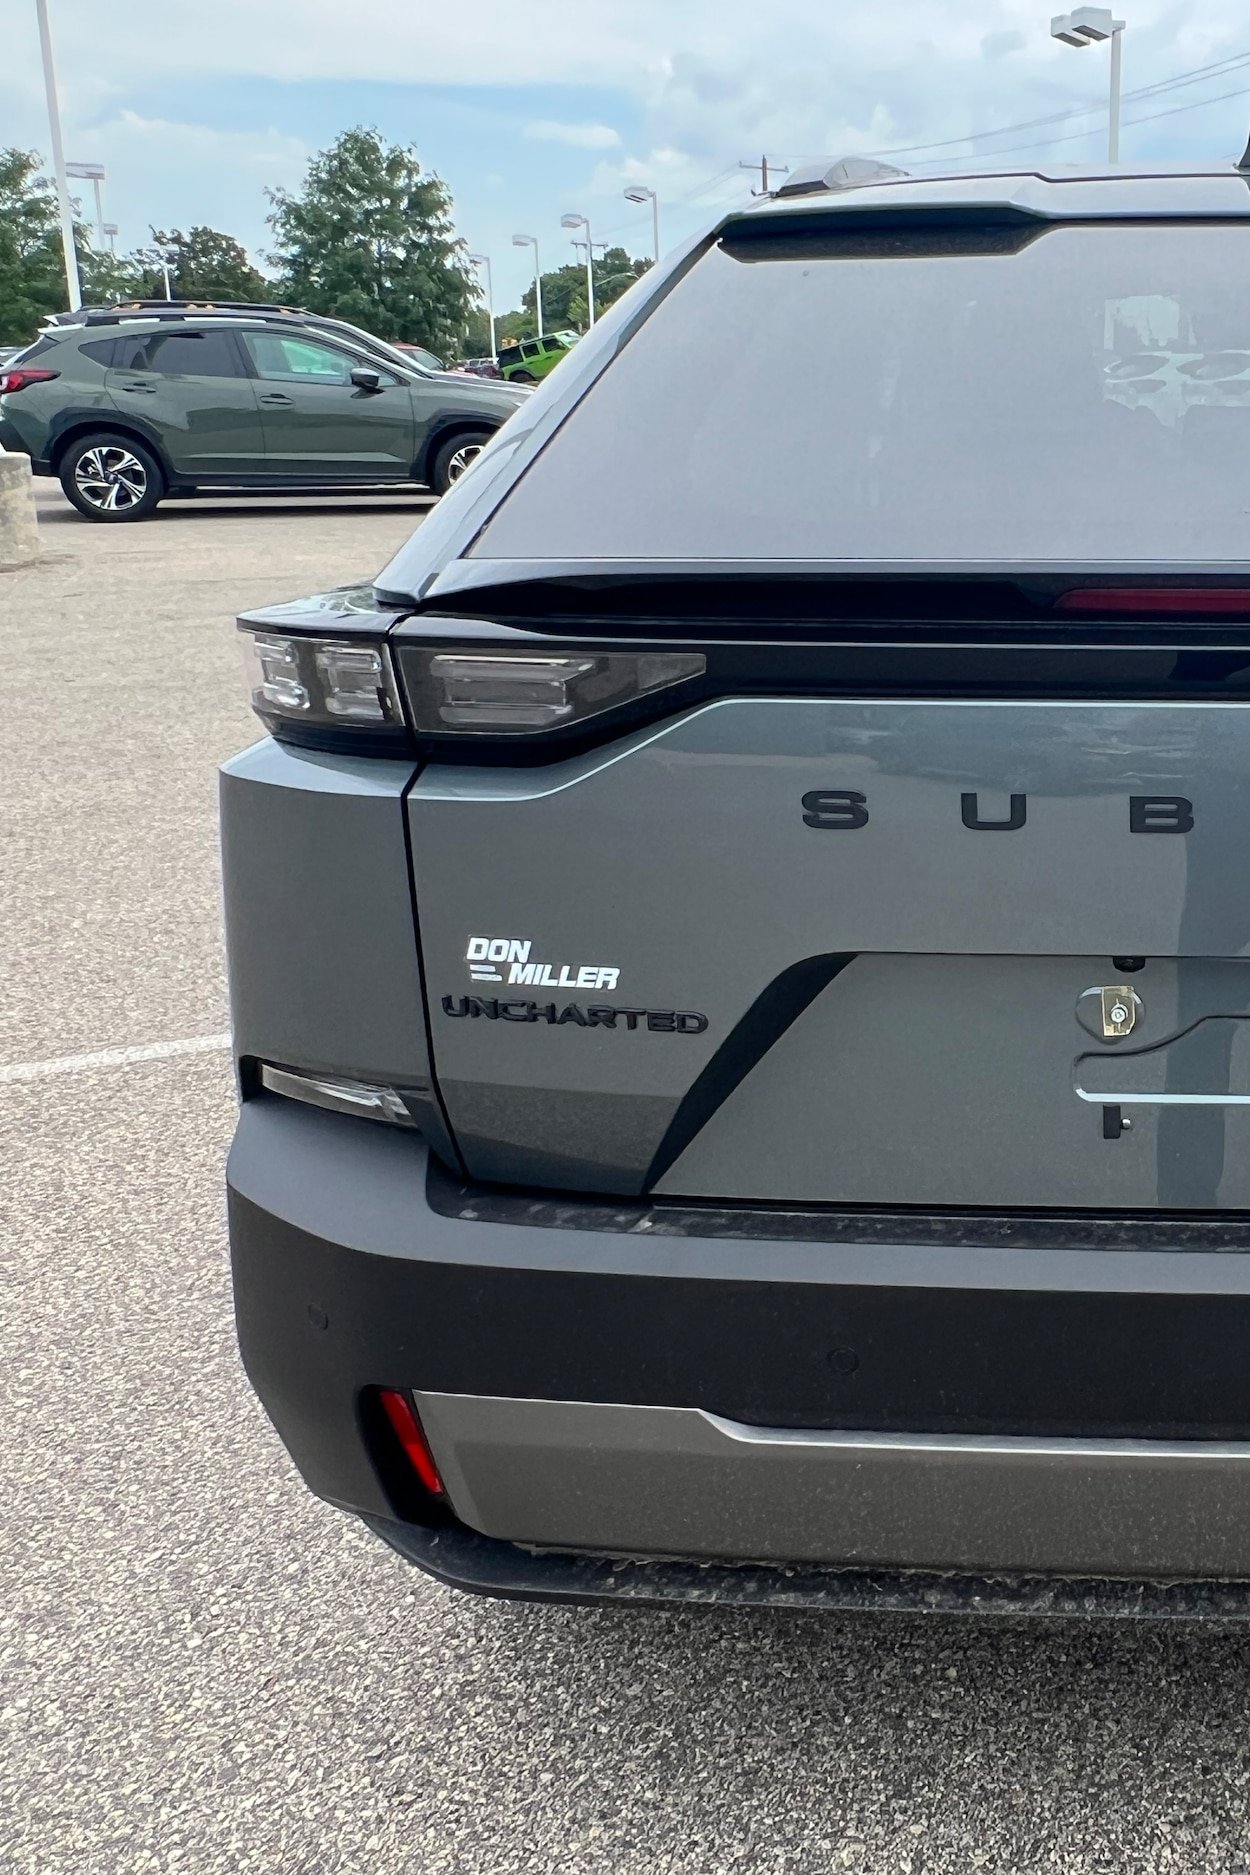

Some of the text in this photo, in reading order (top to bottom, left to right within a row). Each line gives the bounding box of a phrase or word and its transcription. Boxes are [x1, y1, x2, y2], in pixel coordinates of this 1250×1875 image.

[466, 937, 531, 963] DON
[508, 963, 620, 990] MILLER
[441, 994, 709, 1034] UNCHARTED
